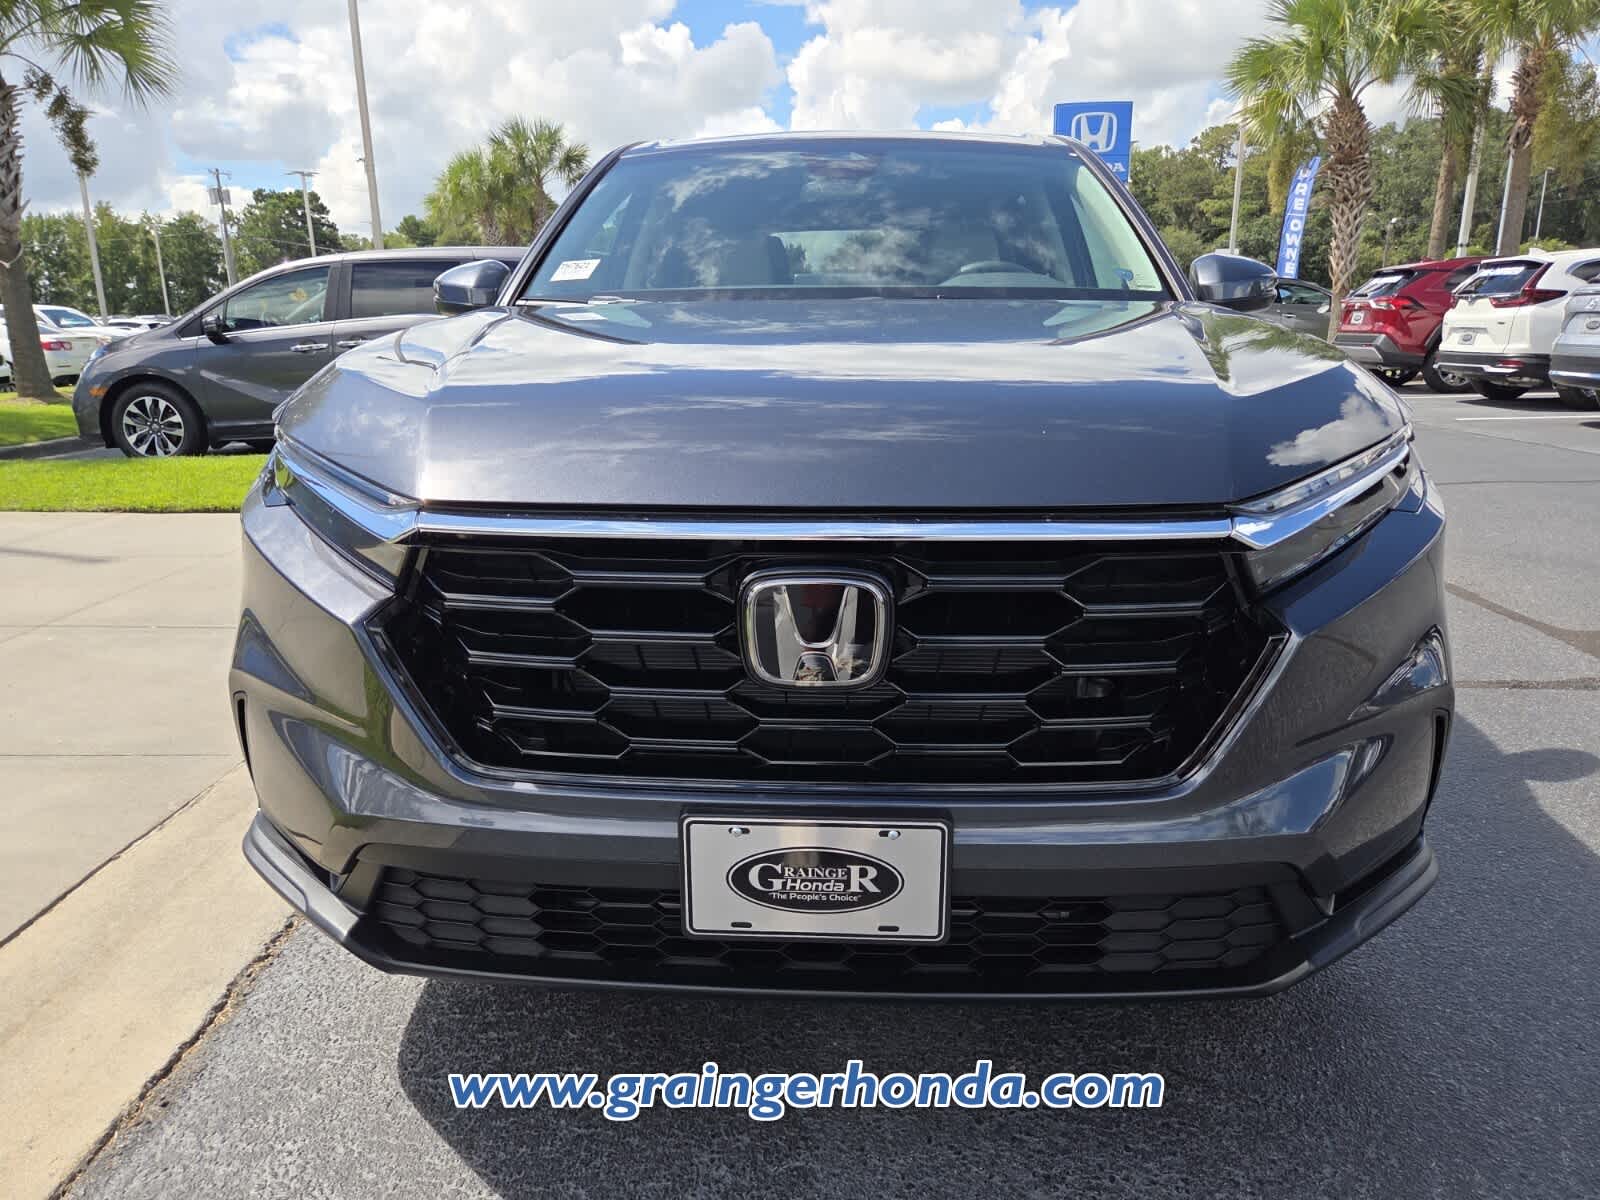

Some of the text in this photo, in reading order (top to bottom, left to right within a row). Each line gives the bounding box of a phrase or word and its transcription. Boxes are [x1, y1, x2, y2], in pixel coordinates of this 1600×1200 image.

[748, 863, 881, 893] GRAINGER
[785, 879, 845, 892] Honda
[789, 893, 827, 901] People's
